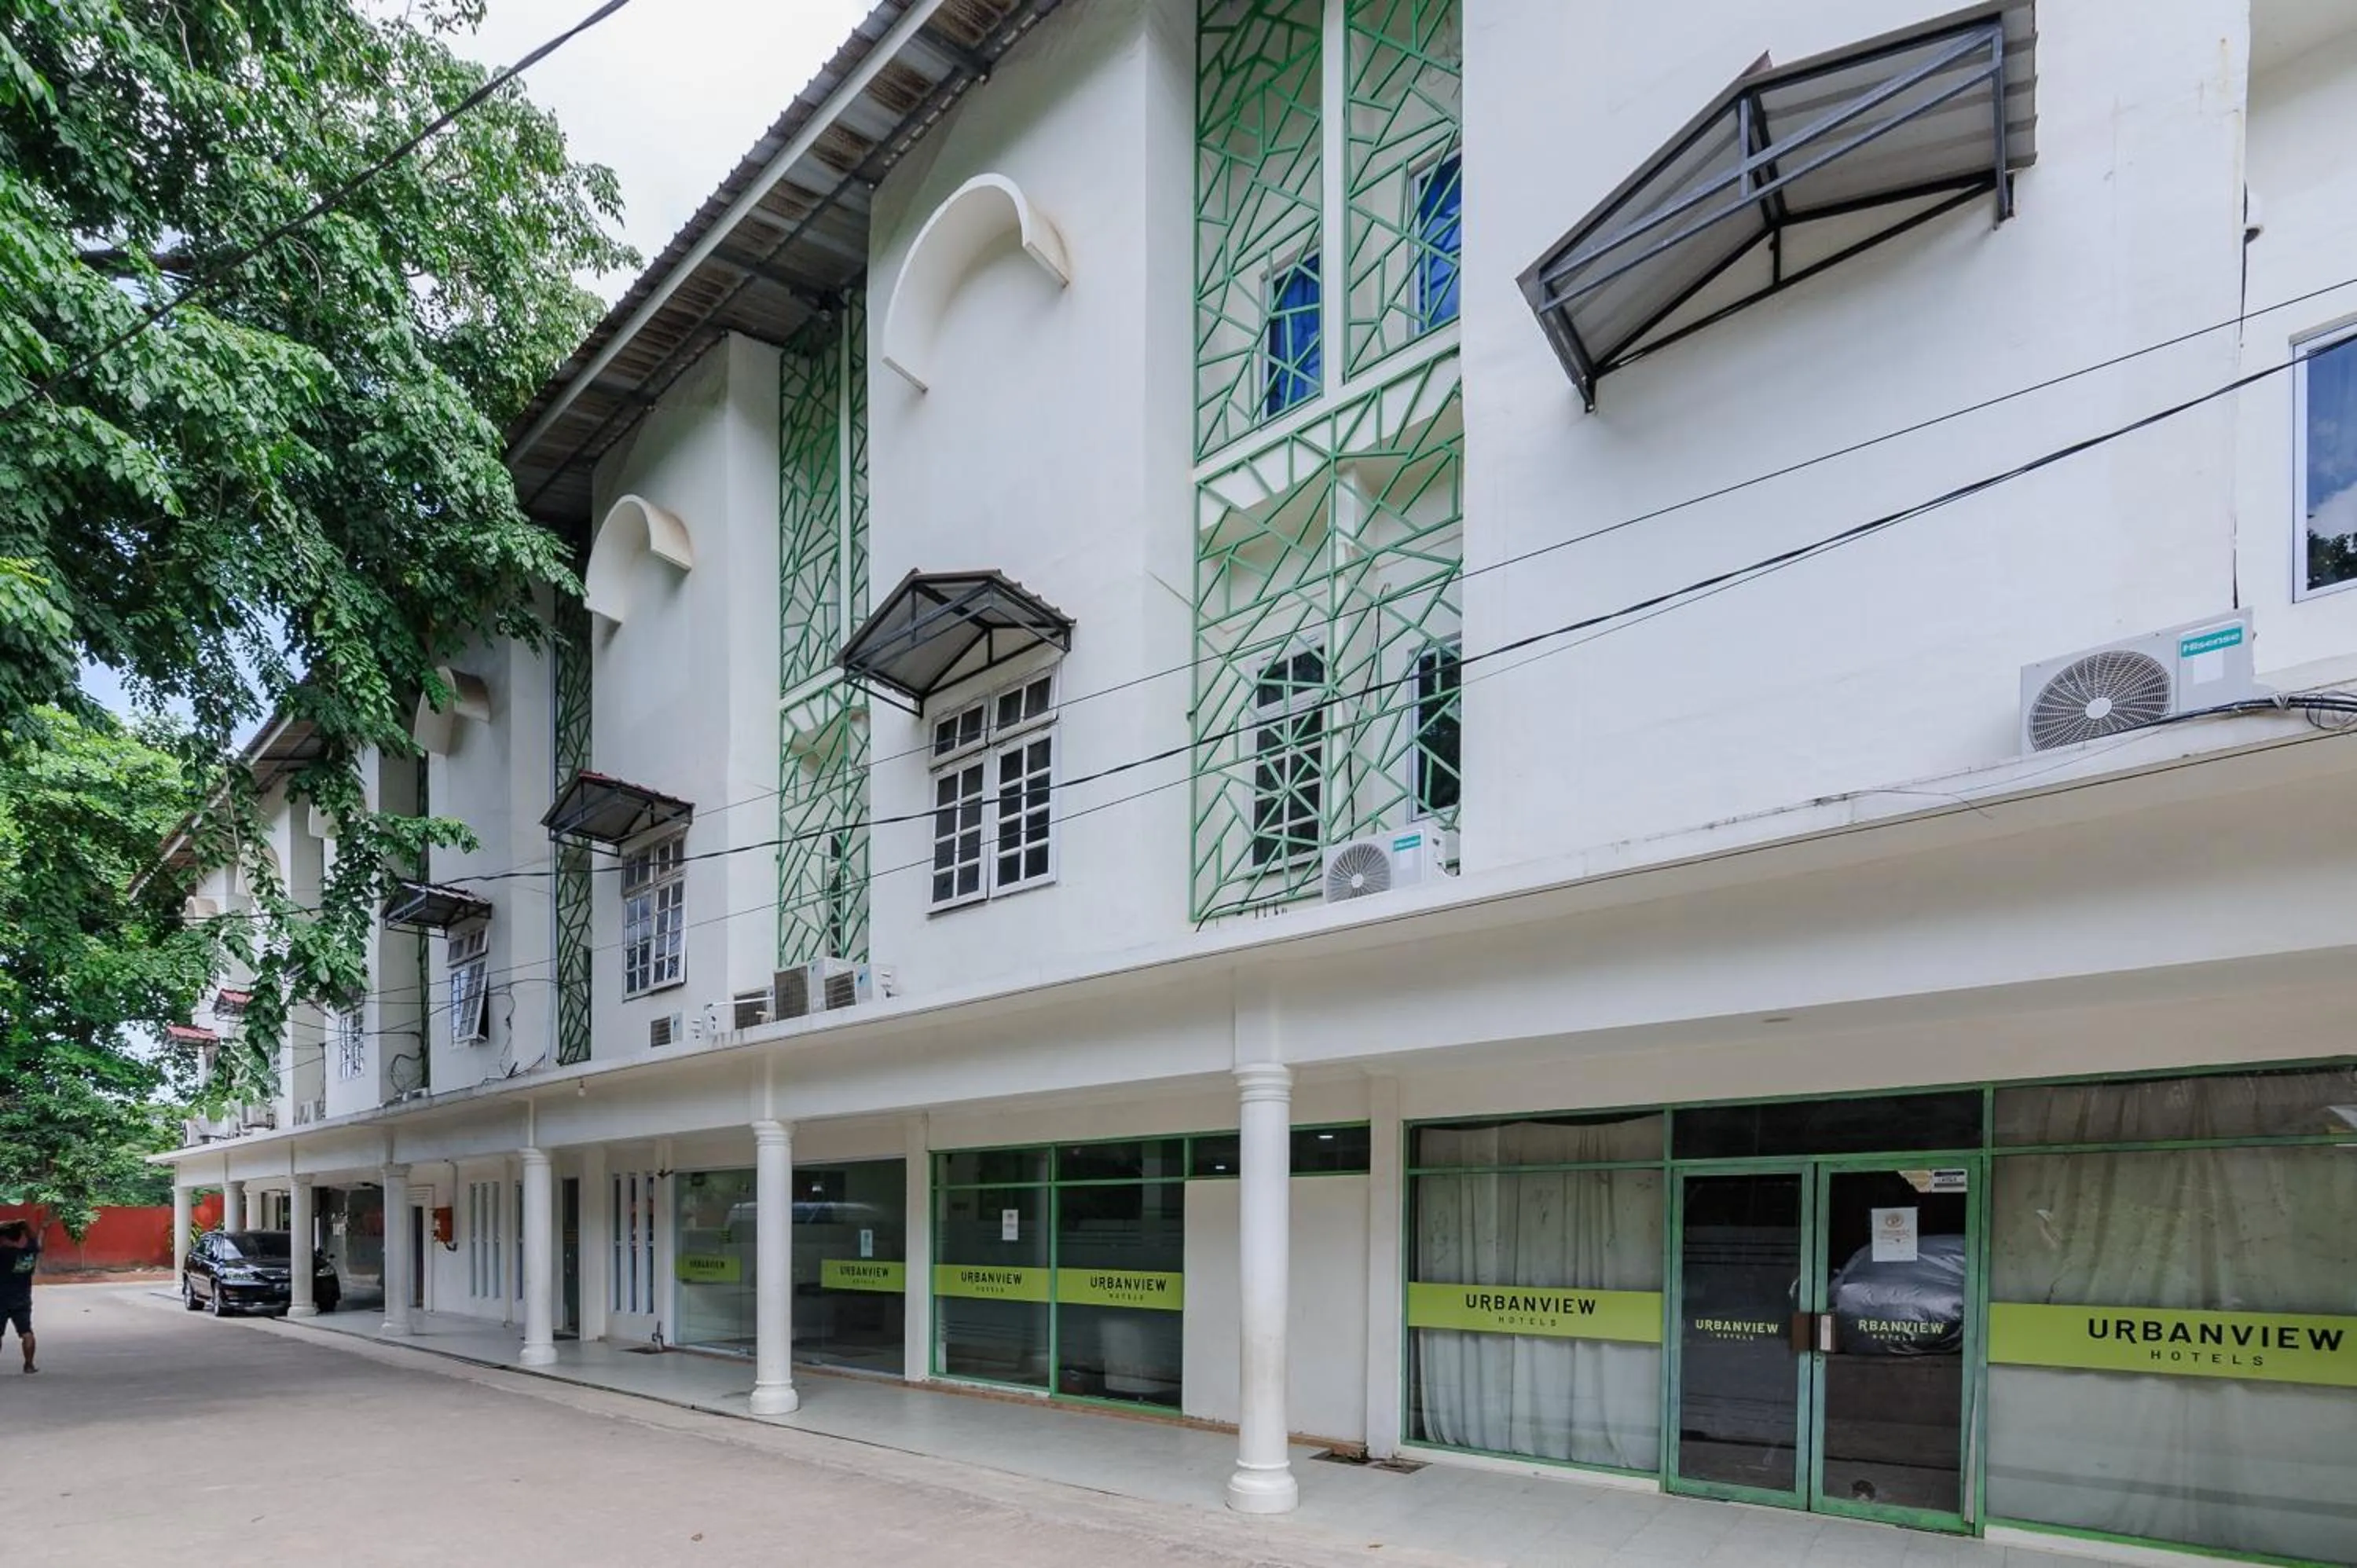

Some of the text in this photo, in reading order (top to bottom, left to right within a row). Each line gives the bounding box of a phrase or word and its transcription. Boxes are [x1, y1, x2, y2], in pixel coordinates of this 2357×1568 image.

[2183, 633, 2239, 653] Hisense
[961, 1271, 1022, 1284] URBANVIEW
[1090, 1276, 1167, 1291] URBANVIEW
[1465, 1294, 1596, 1314] URBANVIEW
[1498, 1316, 1556, 1326] HOTELS
[1695, 1319, 1779, 1334] URBANVIEW
[1858, 1319, 1945, 1334] RBANVIEW
[2088, 1318, 2344, 1352] URBANVIEW
[2150, 1350, 2264, 1366] HOTELS
